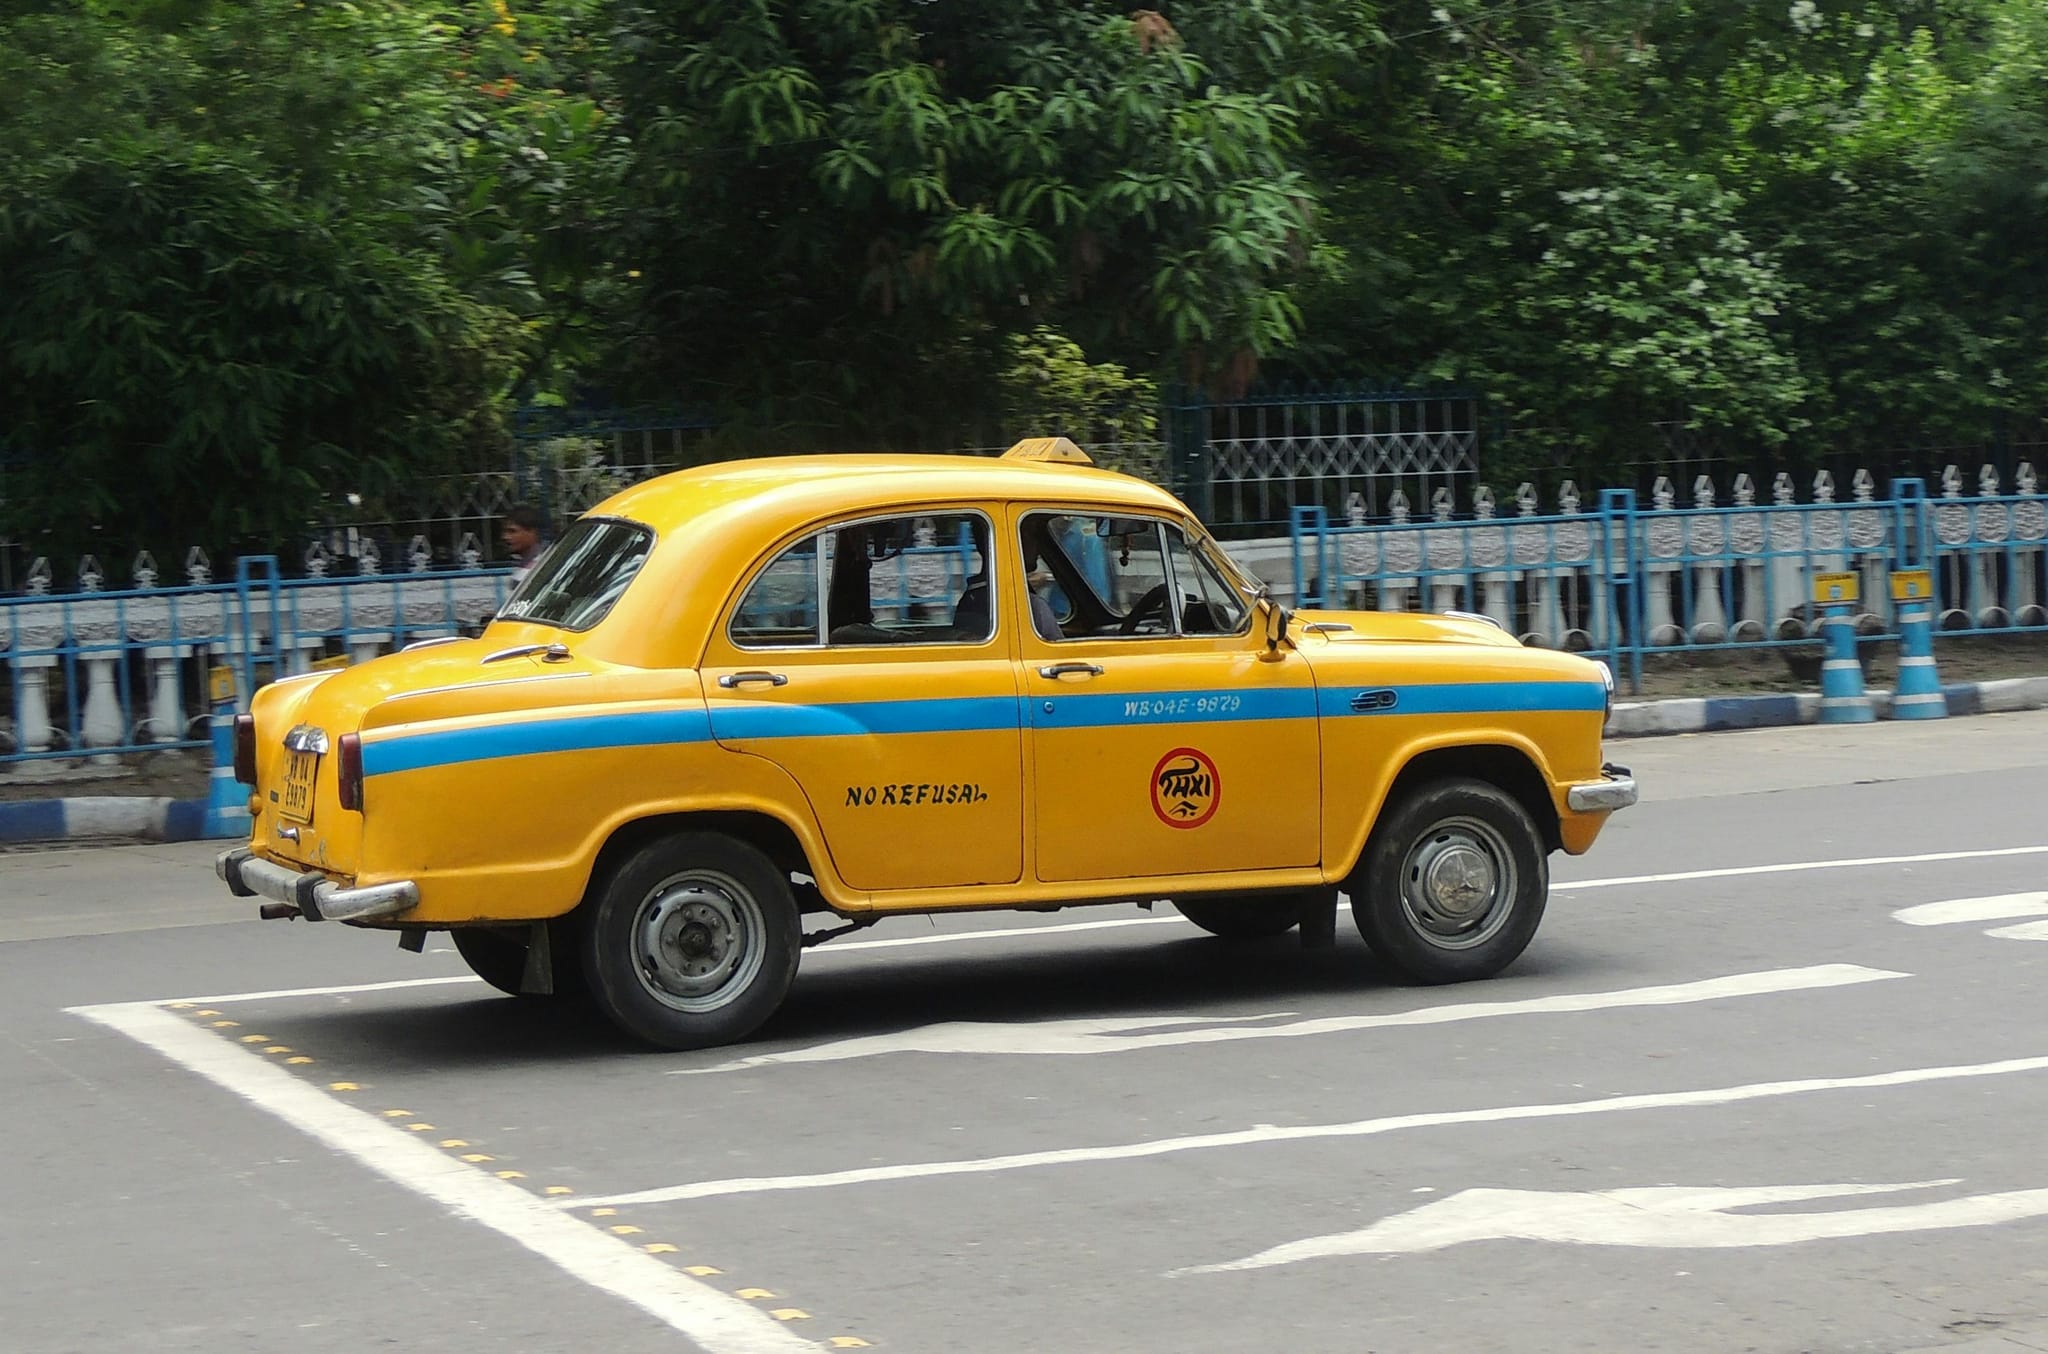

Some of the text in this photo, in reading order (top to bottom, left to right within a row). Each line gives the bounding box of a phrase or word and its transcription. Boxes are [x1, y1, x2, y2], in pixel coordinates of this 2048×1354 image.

[1158, 757, 1211, 799] TAXI
[845, 783, 988, 807] NO REFUSAL
